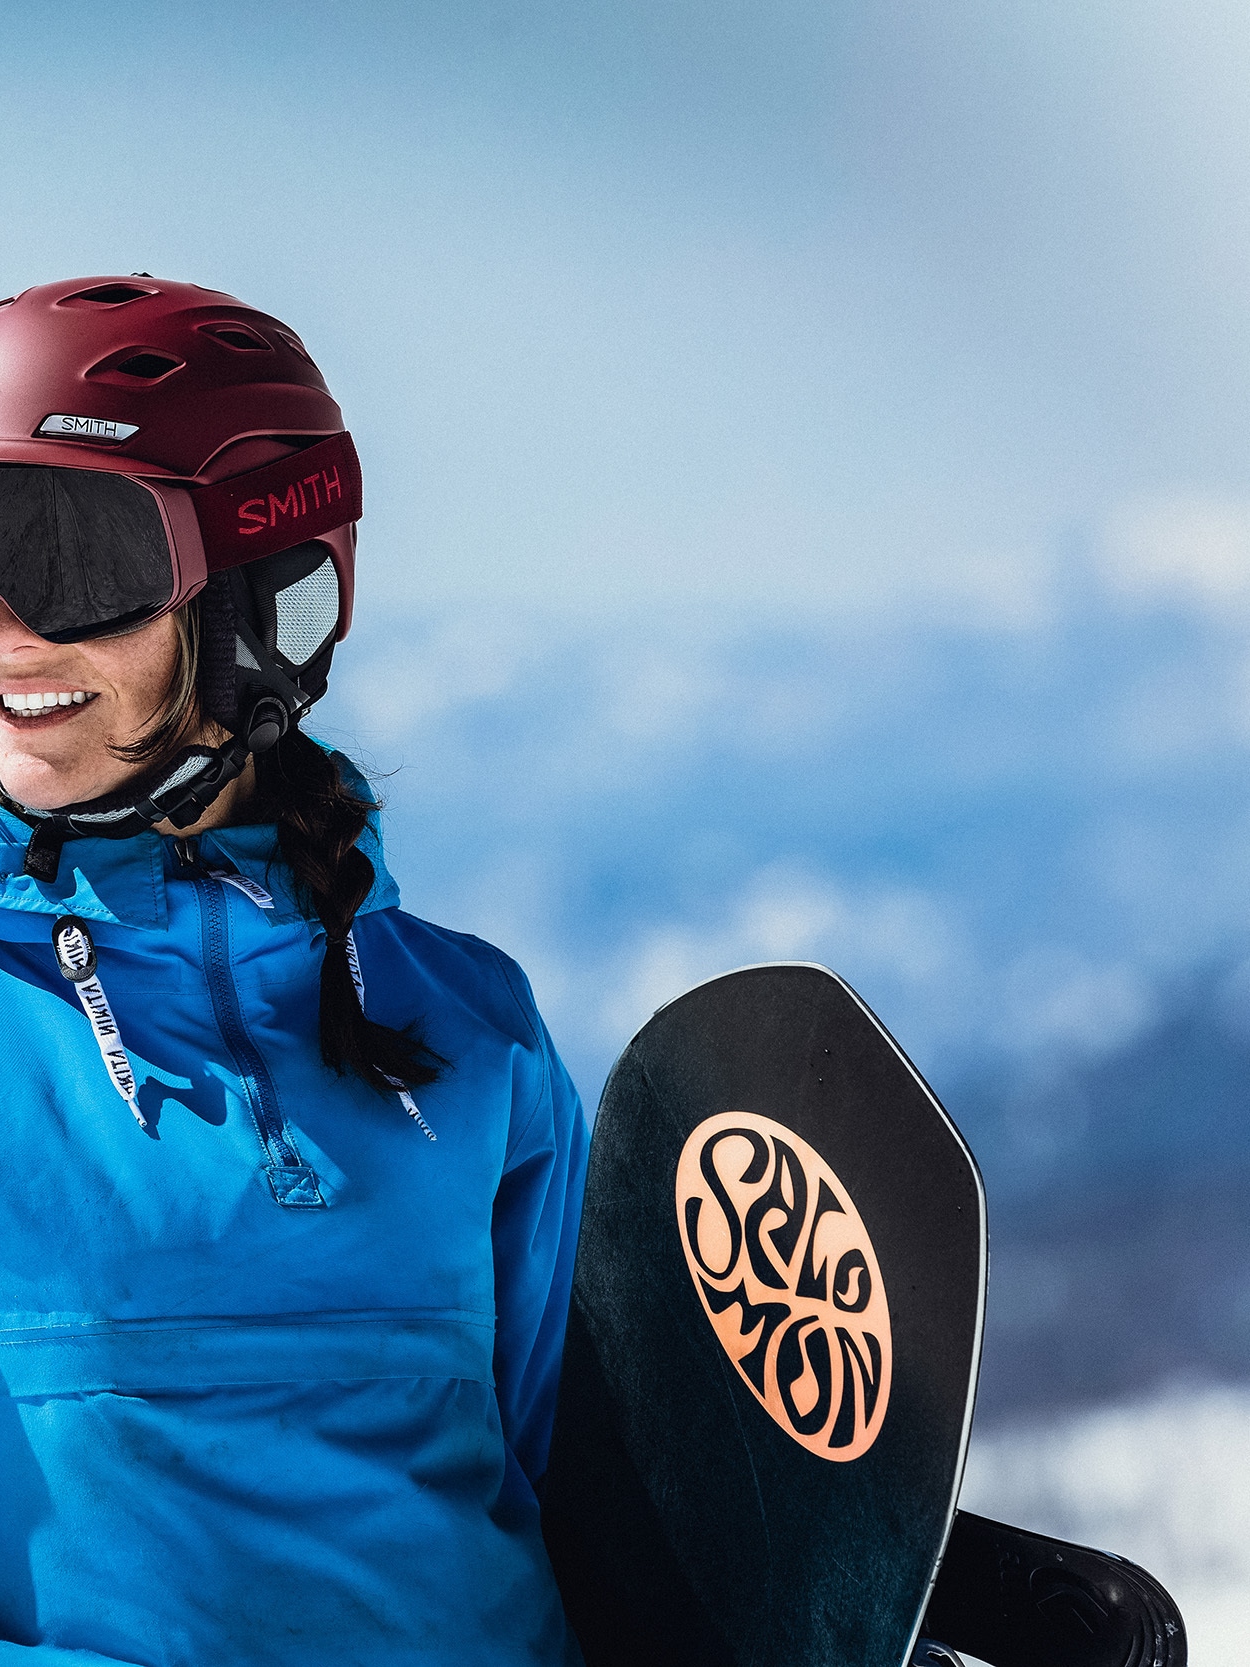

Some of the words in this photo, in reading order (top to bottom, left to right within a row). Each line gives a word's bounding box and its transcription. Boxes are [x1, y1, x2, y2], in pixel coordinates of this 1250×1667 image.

[61, 417, 117, 436] SMITH
[238, 465, 341, 535] SMITH
[81, 982, 117, 1037] NIKITA
